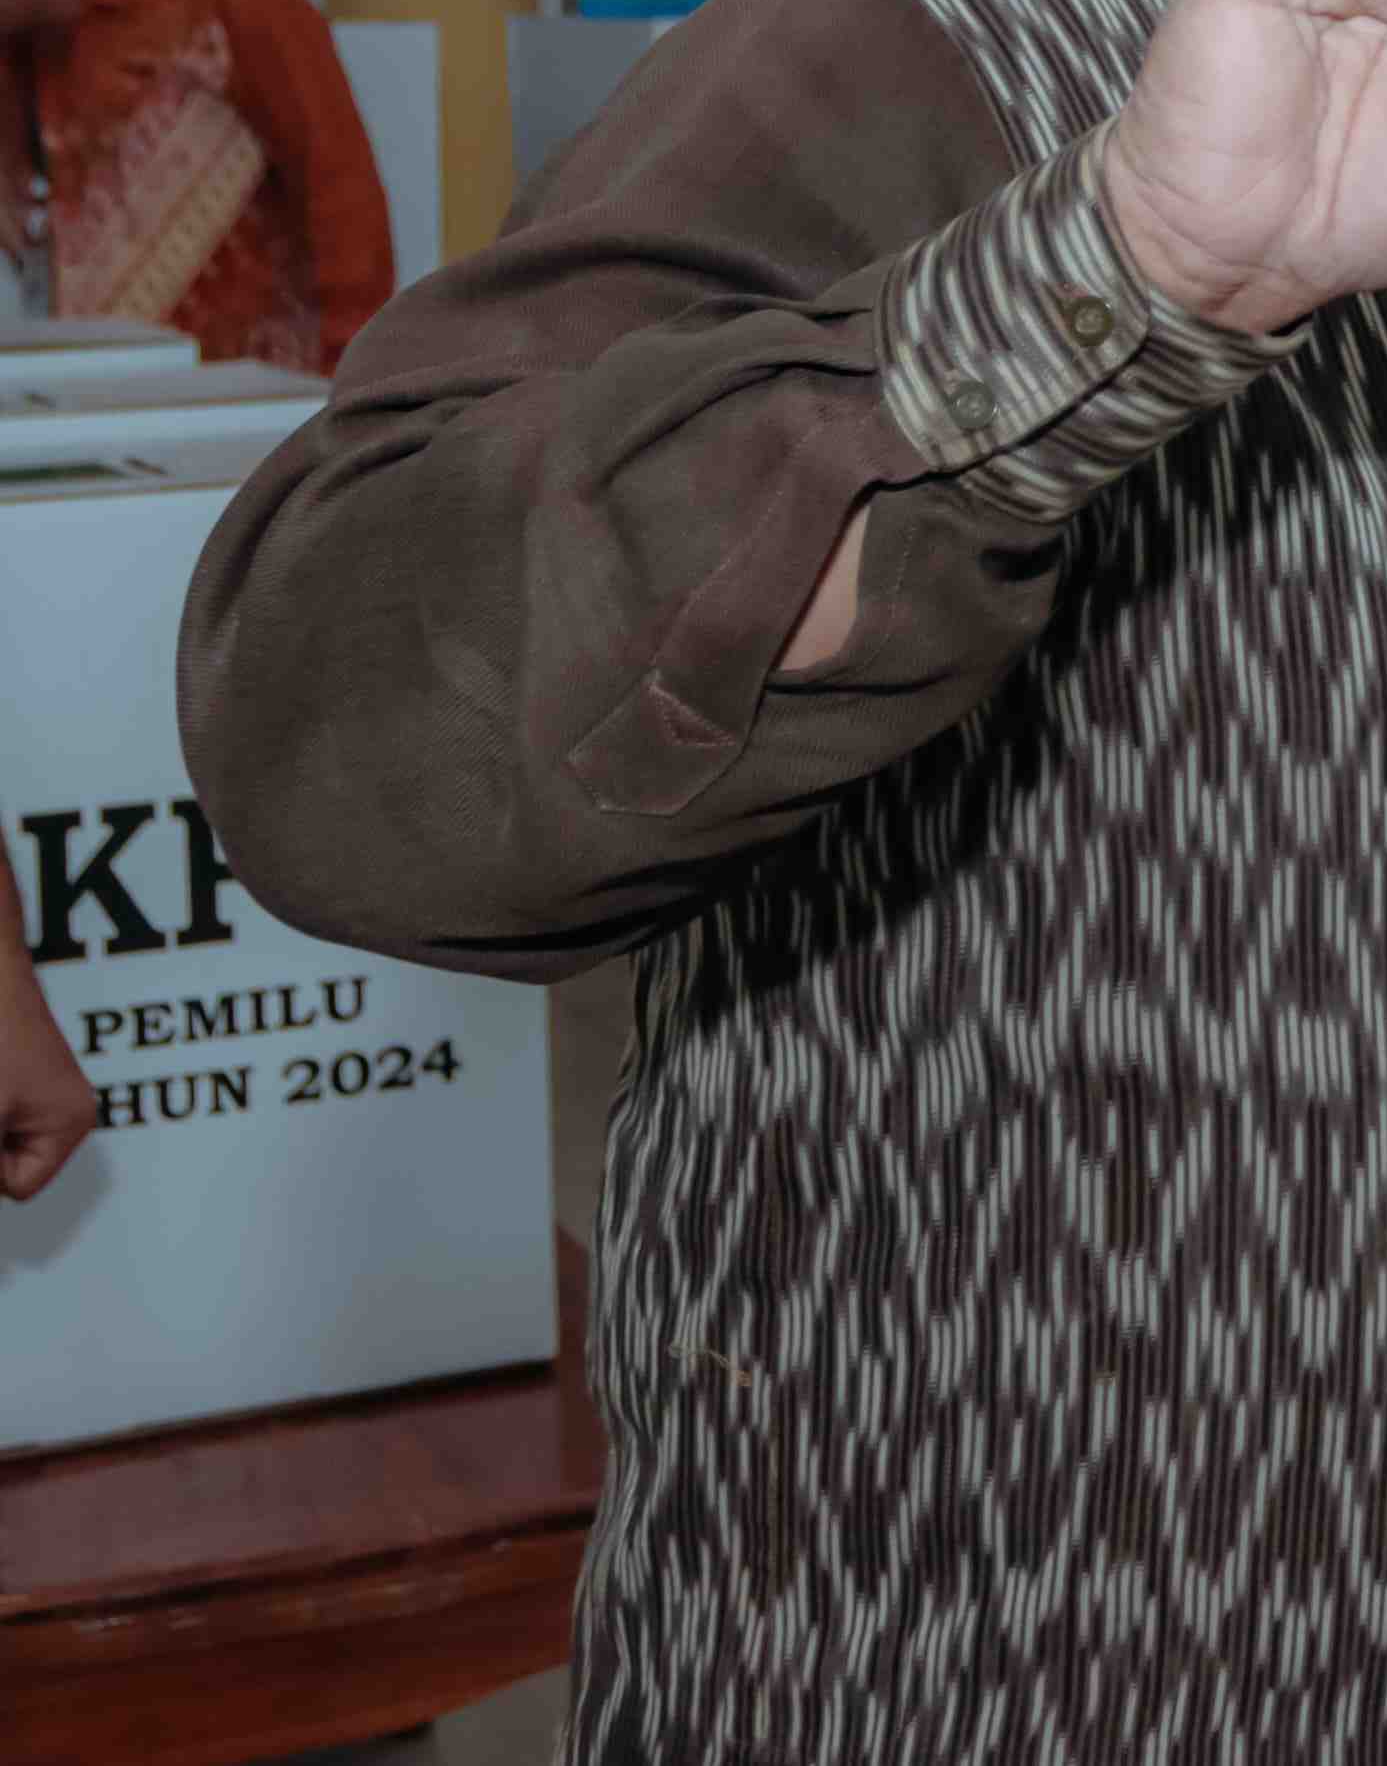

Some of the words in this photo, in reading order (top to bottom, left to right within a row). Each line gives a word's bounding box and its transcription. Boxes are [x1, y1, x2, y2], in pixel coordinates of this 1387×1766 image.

[78, 975, 368, 1057] PEMILU
[95, 1065, 252, 1131] HUN
[282, 1035, 462, 1106] 2024
